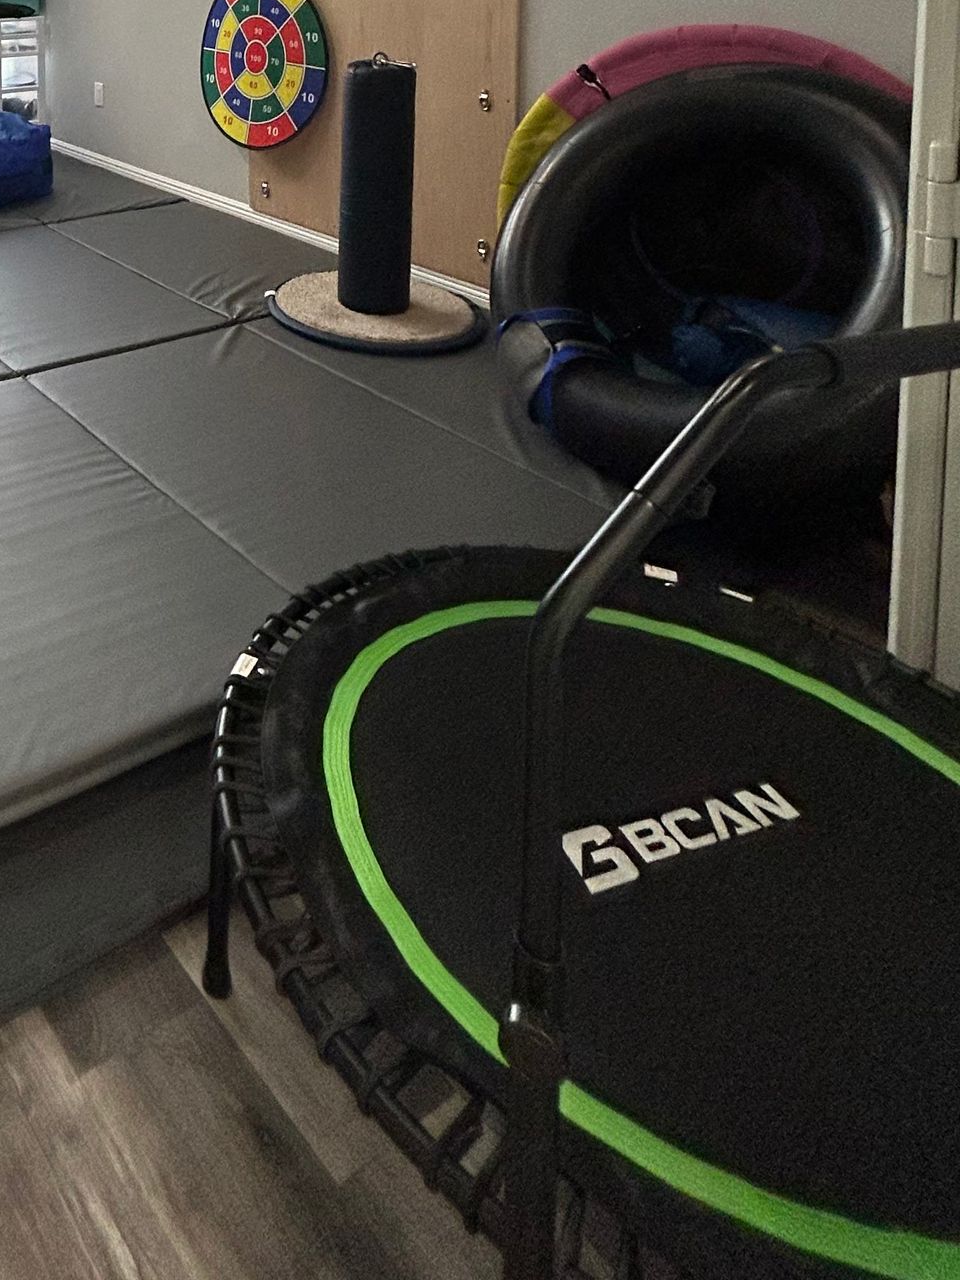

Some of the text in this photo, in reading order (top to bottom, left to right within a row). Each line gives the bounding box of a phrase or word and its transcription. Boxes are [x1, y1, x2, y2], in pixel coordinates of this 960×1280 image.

[270, 7, 280, 15] 40
[211, 18, 220, 28] 10
[305, 32, 319, 43] 10
[250, 54, 262, 63] 100
[271, 57, 280, 66] 70
[206, 73, 215, 83] 10
[285, 79, 296, 89] 20
[232, 98, 241, 107] 40
[301, 92, 315, 104] 10
[223, 115, 233, 126] 10
[266, 125, 279, 137] 10
[619, 782, 801, 864] BCAN
